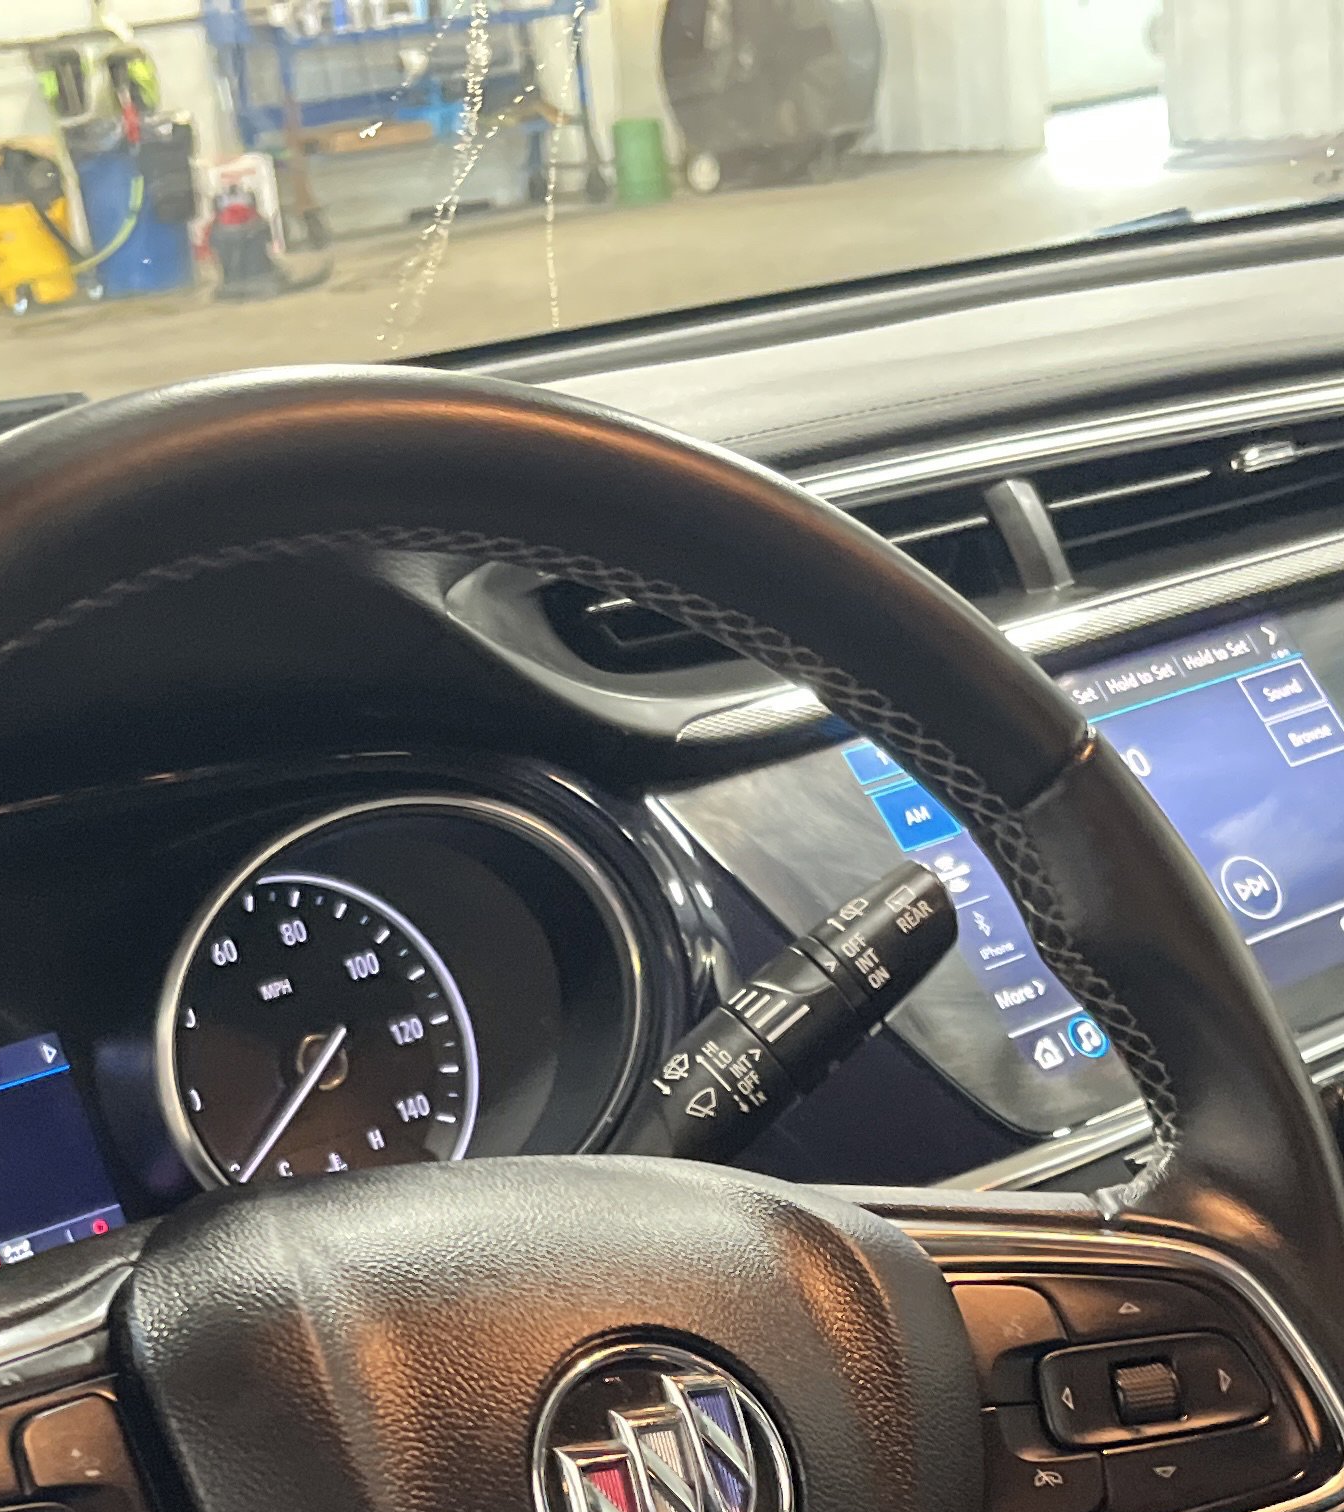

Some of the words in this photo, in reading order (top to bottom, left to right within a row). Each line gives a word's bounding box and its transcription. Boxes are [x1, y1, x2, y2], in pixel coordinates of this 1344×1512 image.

[1182, 649, 1213, 671] Hold
[1212, 648, 1226, 662] to
[1226, 640, 1251, 659] Set
[1106, 674, 1138, 695] Hold
[1138, 671, 1153, 686] to
[1154, 662, 1176, 681] Set
[1263, 678, 1303, 703] Sound
[1072, 686, 1099, 705] Set
[1288, 724, 1333, 748] Browse
[1120, 747, 1152, 778] 0
[905, 805, 932, 826] AM
[895, 899, 933, 935] REAR
[279, 919, 307, 946] 80
[841, 931, 867, 959] OFF
[210, 938, 238, 967] 60
[855, 947, 881, 974] INT
[979, 941, 1016, 961] iPhone
[344, 952, 380, 981] 100
[867, 964, 892, 991] ON
[259, 978, 293, 1001] MPH
[994, 984, 1034, 1010] More
[389, 1016, 424, 1046] 120
[701, 1040, 720, 1058] HI
[712, 1049, 733, 1069] LO
[728, 1054, 753, 1079] INT
[737, 1070, 760, 1095] OFF
[396, 1094, 430, 1123] 140
[367, 1128, 385, 1150] H
